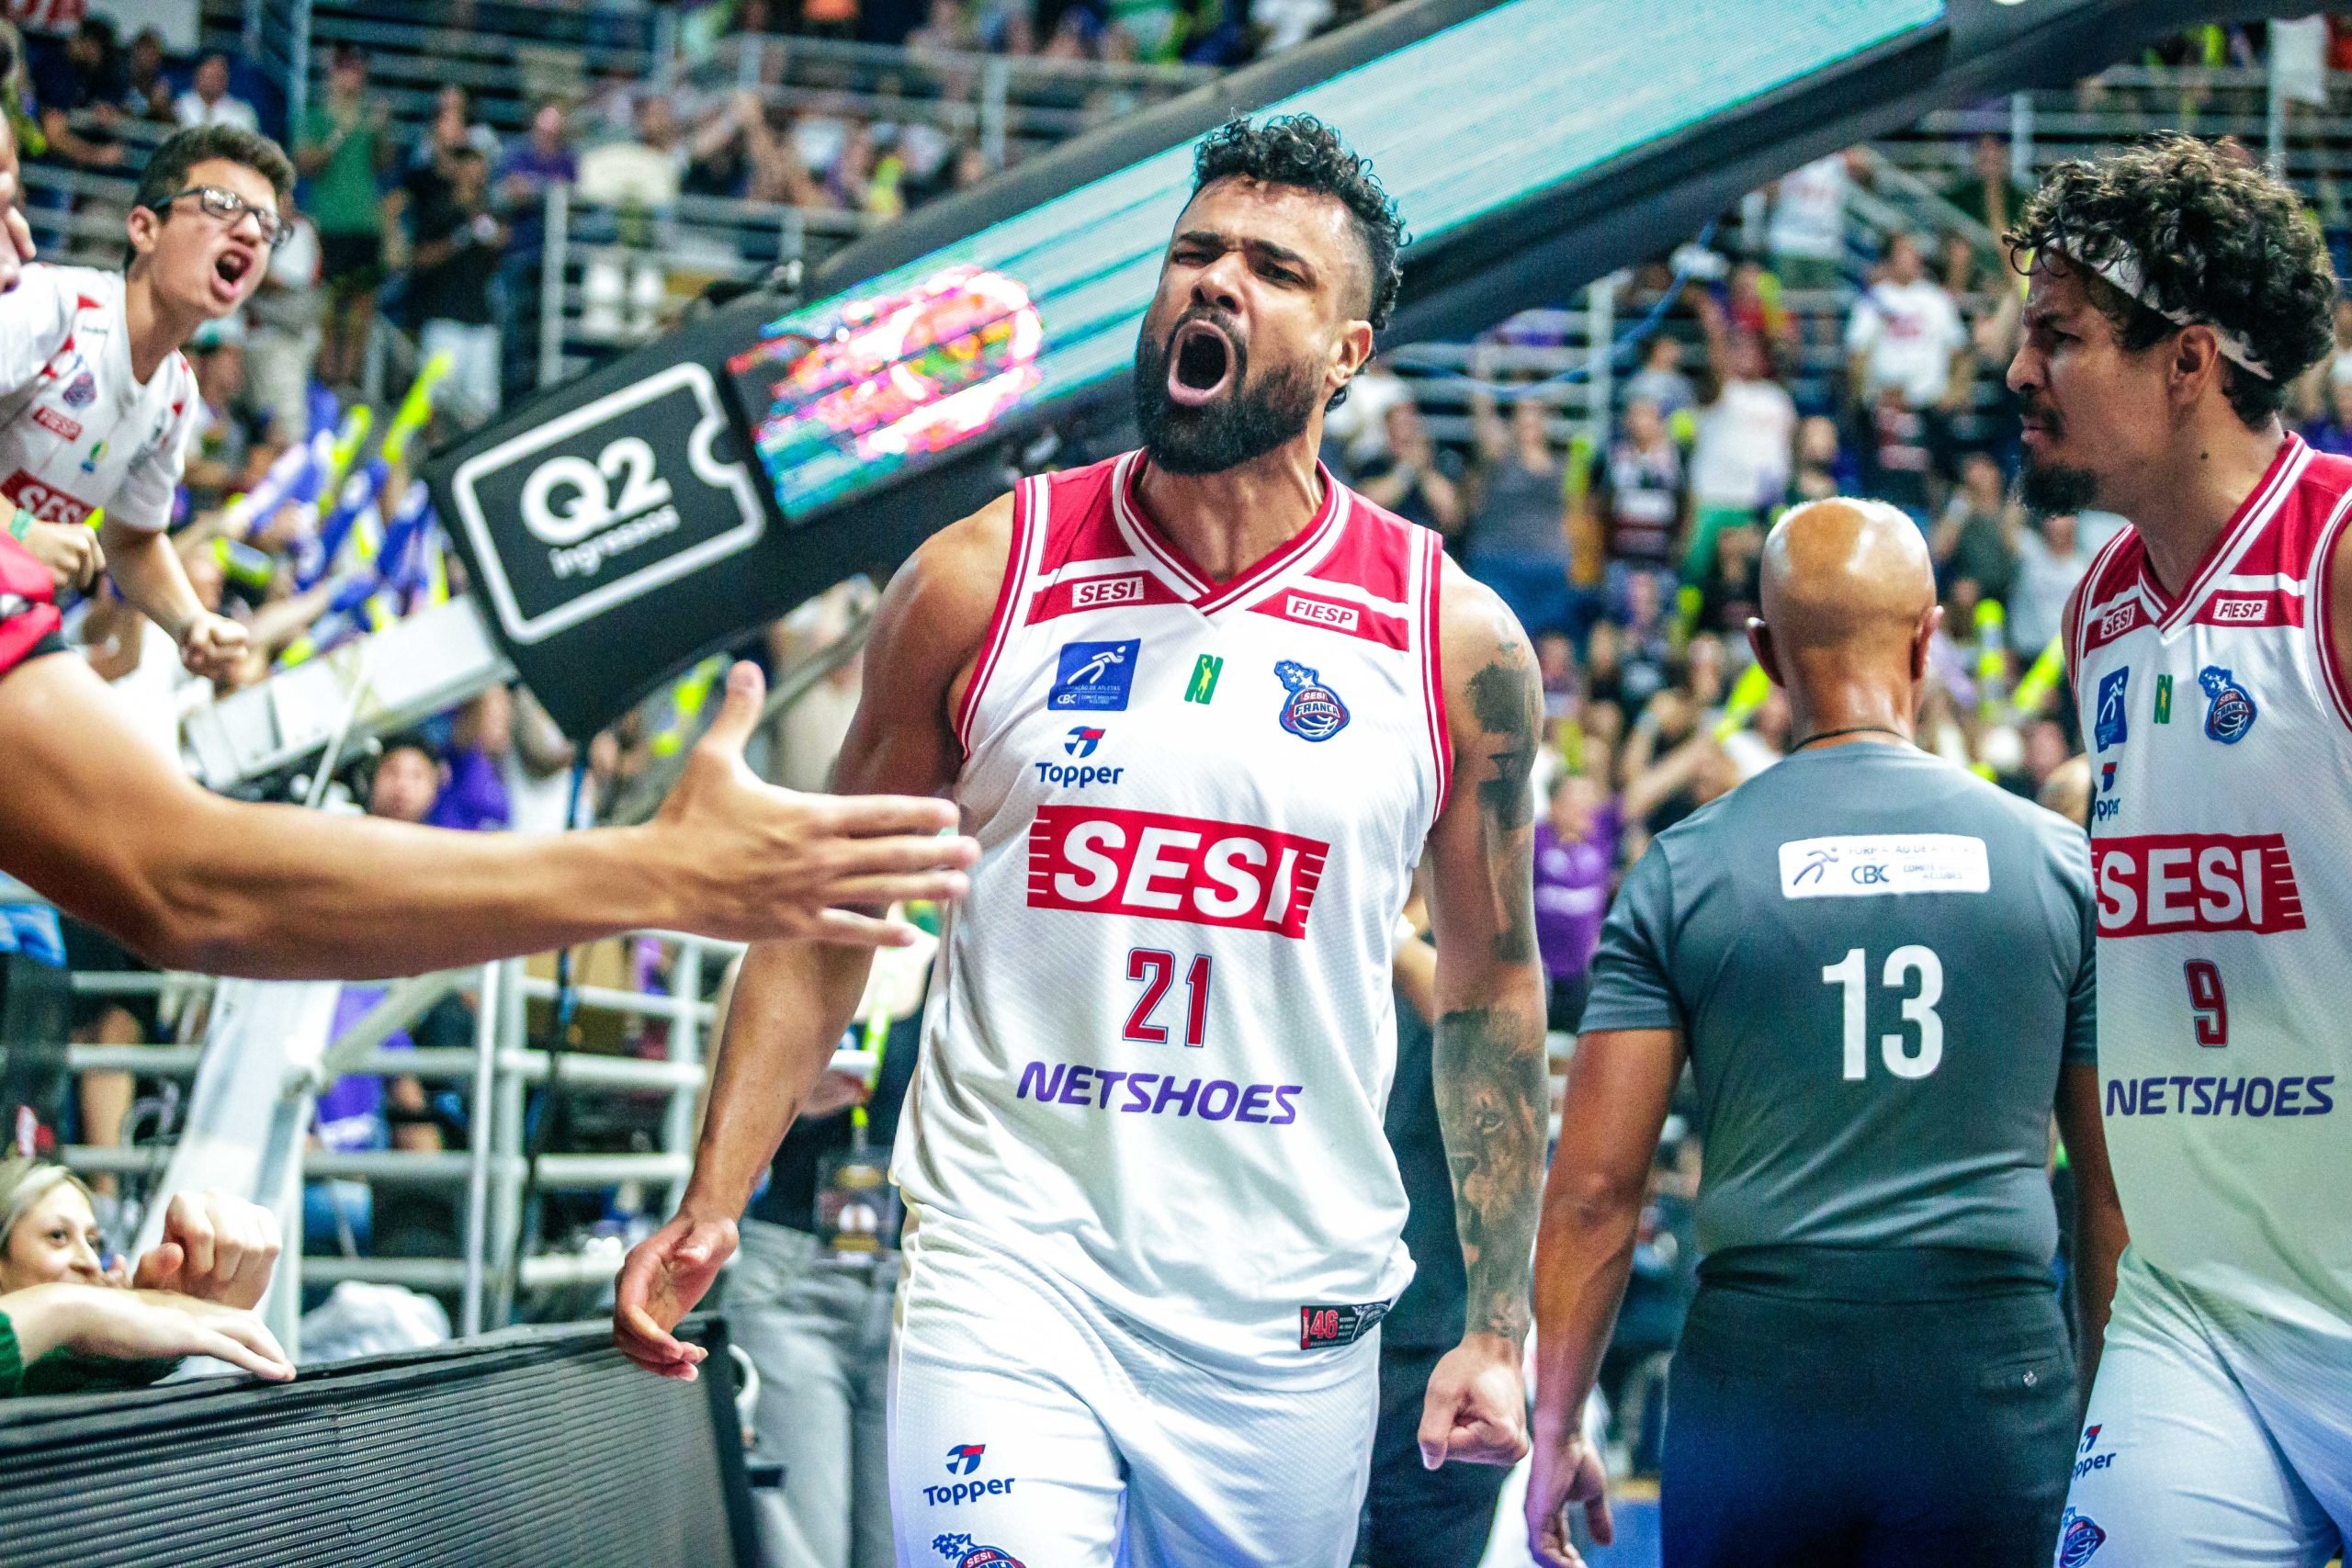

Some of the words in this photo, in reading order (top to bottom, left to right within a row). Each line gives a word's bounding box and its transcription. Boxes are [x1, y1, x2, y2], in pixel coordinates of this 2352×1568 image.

[520, 436, 673, 547] Q2
[1078, 581, 1137, 604] SESI
[1292, 600, 1353, 625] FIESP
[2103, 607, 2133, 635] SESI
[2218, 602, 2263, 618] FIESP
[1057, 694, 1078, 705] CBC
[1295, 703, 1339, 716] FRANCA
[1303, 692, 1327, 701] SESI
[1035, 762, 1125, 788] Topper
[2096, 797, 2120, 822] pper
[1054, 819, 1299, 925] SESI
[1851, 863, 1890, 885] CBC
[2098, 845, 2263, 930] SESI
[1122, 946, 1212, 1048] 21
[2183, 958, 2229, 1048] 9
[1822, 944, 1944, 1080] 13
[1016, 1060, 1303, 1124] NETSHOES
[2106, 1075, 2335, 1117] NETSHOES
[1309, 1309, 1339, 1339] 46
[2073, 1452, 2117, 1481] pper
[922, 1477, 1016, 1506] Topper
[967, 1551, 992, 1567] SESI
